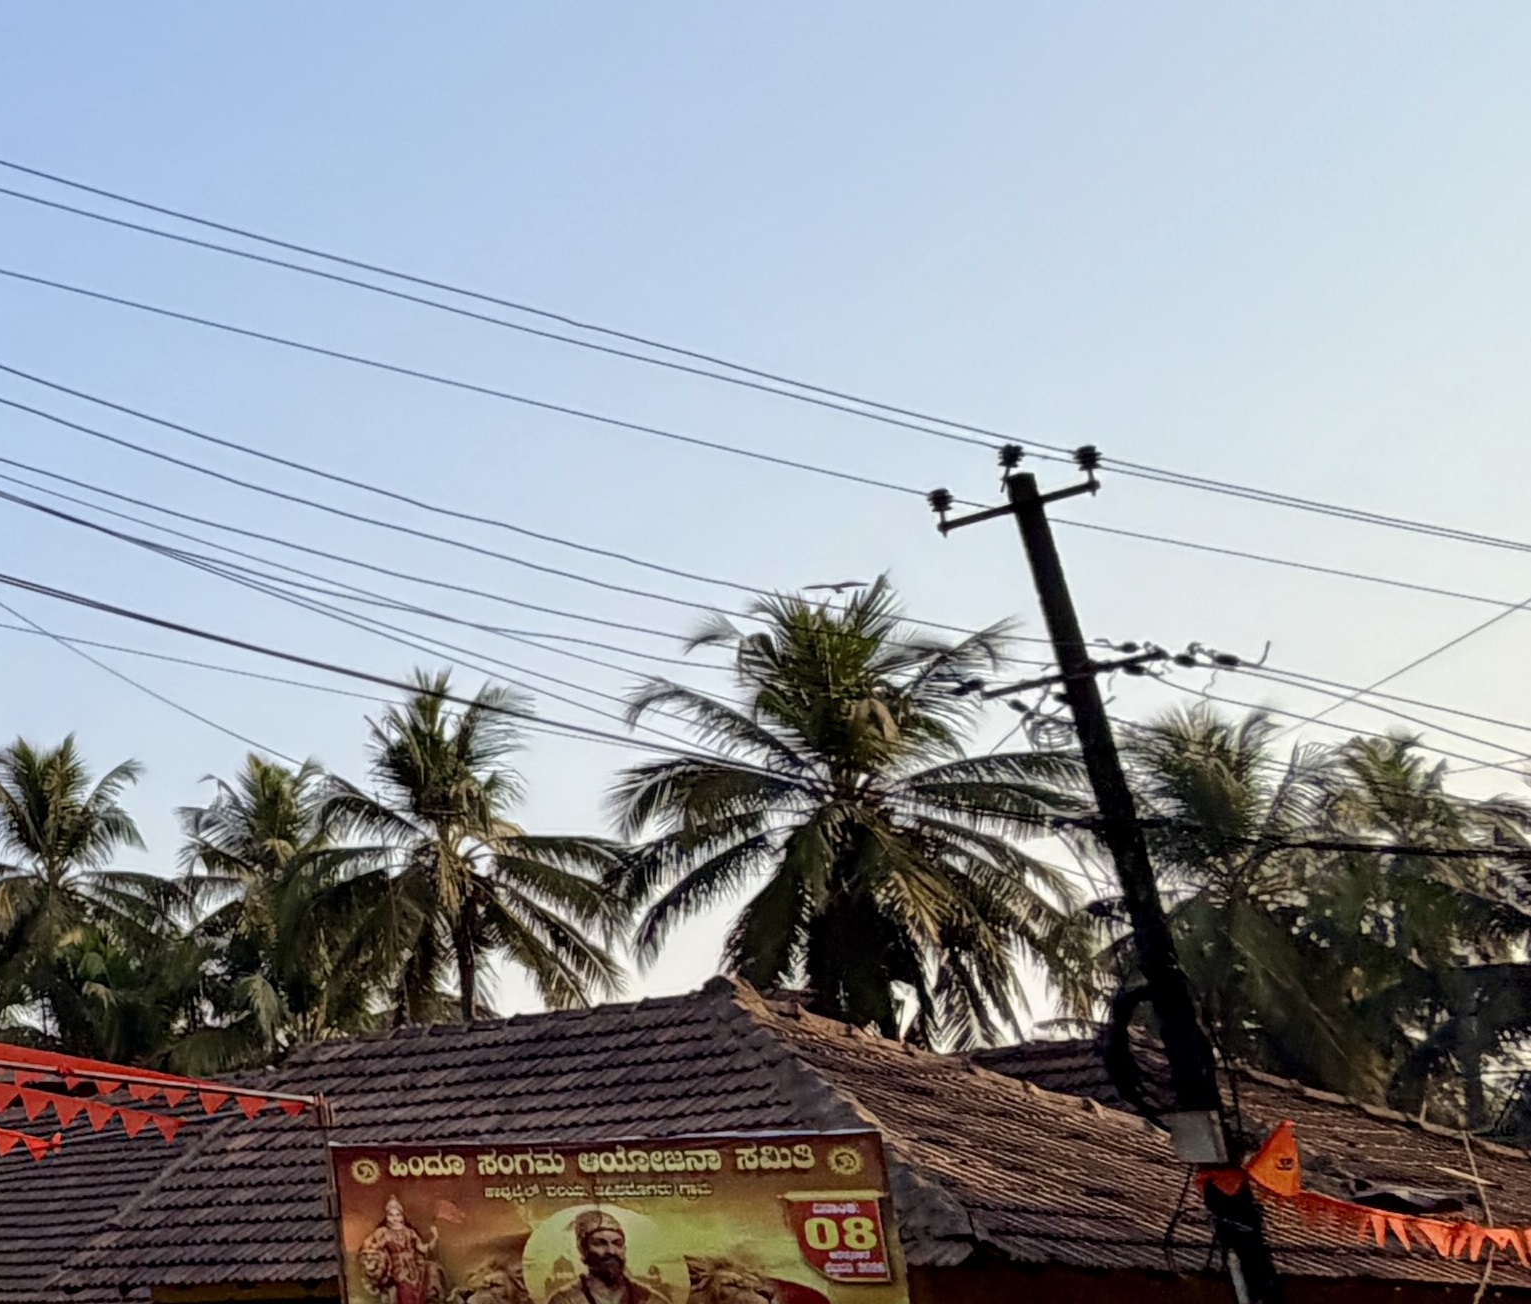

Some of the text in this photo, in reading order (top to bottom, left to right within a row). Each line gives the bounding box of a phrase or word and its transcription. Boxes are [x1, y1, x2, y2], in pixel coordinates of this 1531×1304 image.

[389, 1142, 816, 1177] ಹಿಂದೂ ಸಂಗಮ ಆಯೋಜನಾ ಸಮಿತಿ
[804, 1216, 877, 1251] 08
